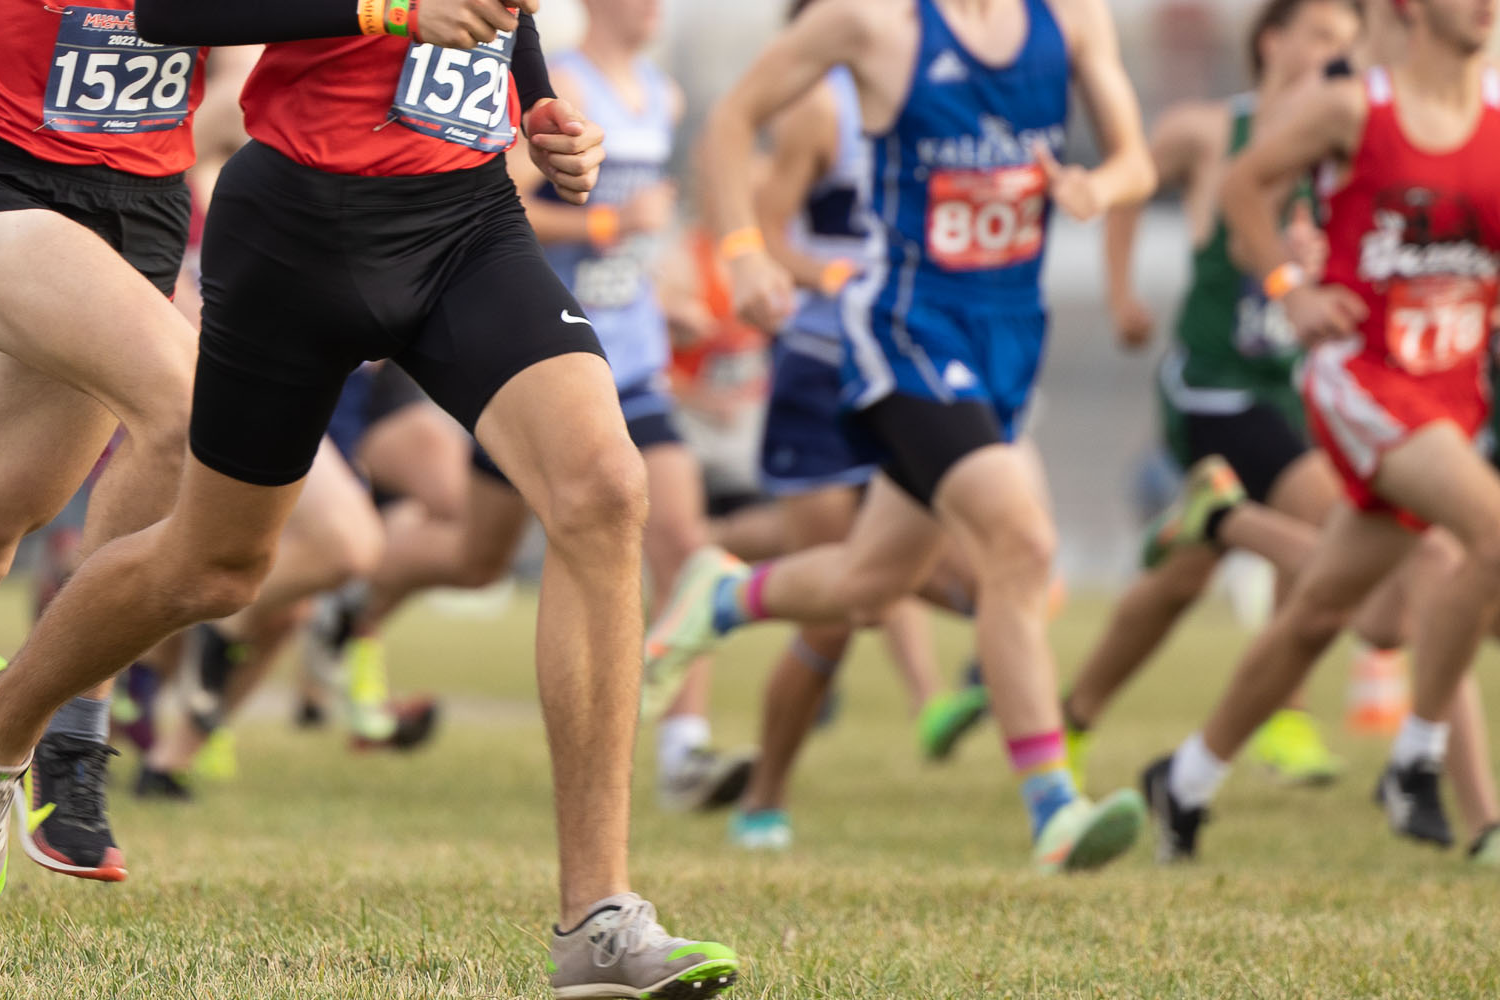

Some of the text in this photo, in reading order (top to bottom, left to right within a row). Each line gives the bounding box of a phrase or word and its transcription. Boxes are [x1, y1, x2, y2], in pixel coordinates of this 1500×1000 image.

[107, 34, 135, 47] 2022
[55, 50, 191, 111] 1528
[404, 42, 509, 128] 1529
